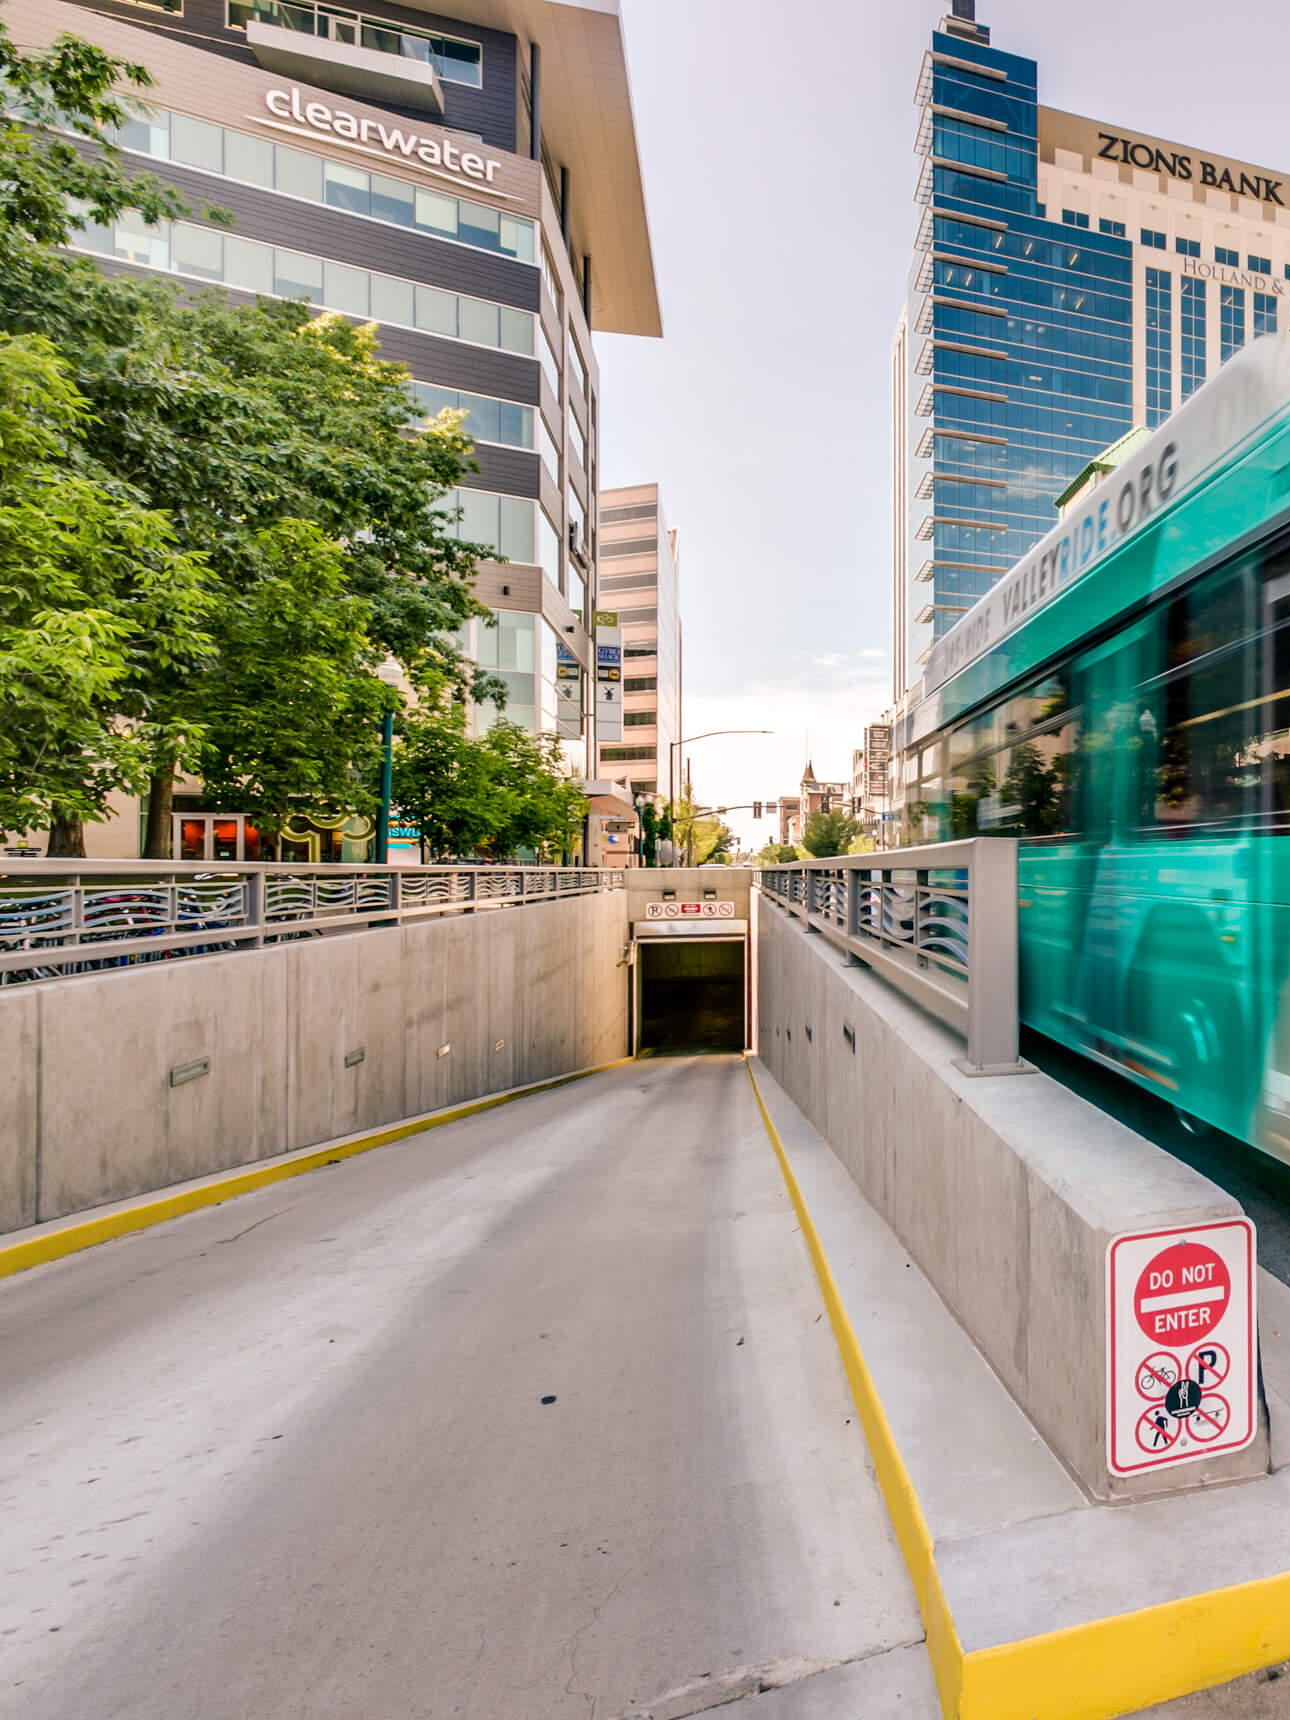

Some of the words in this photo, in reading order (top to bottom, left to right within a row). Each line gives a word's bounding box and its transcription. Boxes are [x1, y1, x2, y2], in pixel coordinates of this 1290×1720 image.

[265, 87, 502, 182] clearwater
[1098, 132, 1192, 180] ZIONS
[1200, 160, 1285, 206] BANK
[1183, 256, 1266, 291] HOLLAND
[1271, 278, 1285, 297] &
[1149, 1270, 1173, 1290] DO
[1181, 1263, 1216, 1284] NOT
[1155, 1307, 1211, 1333] ENTER
